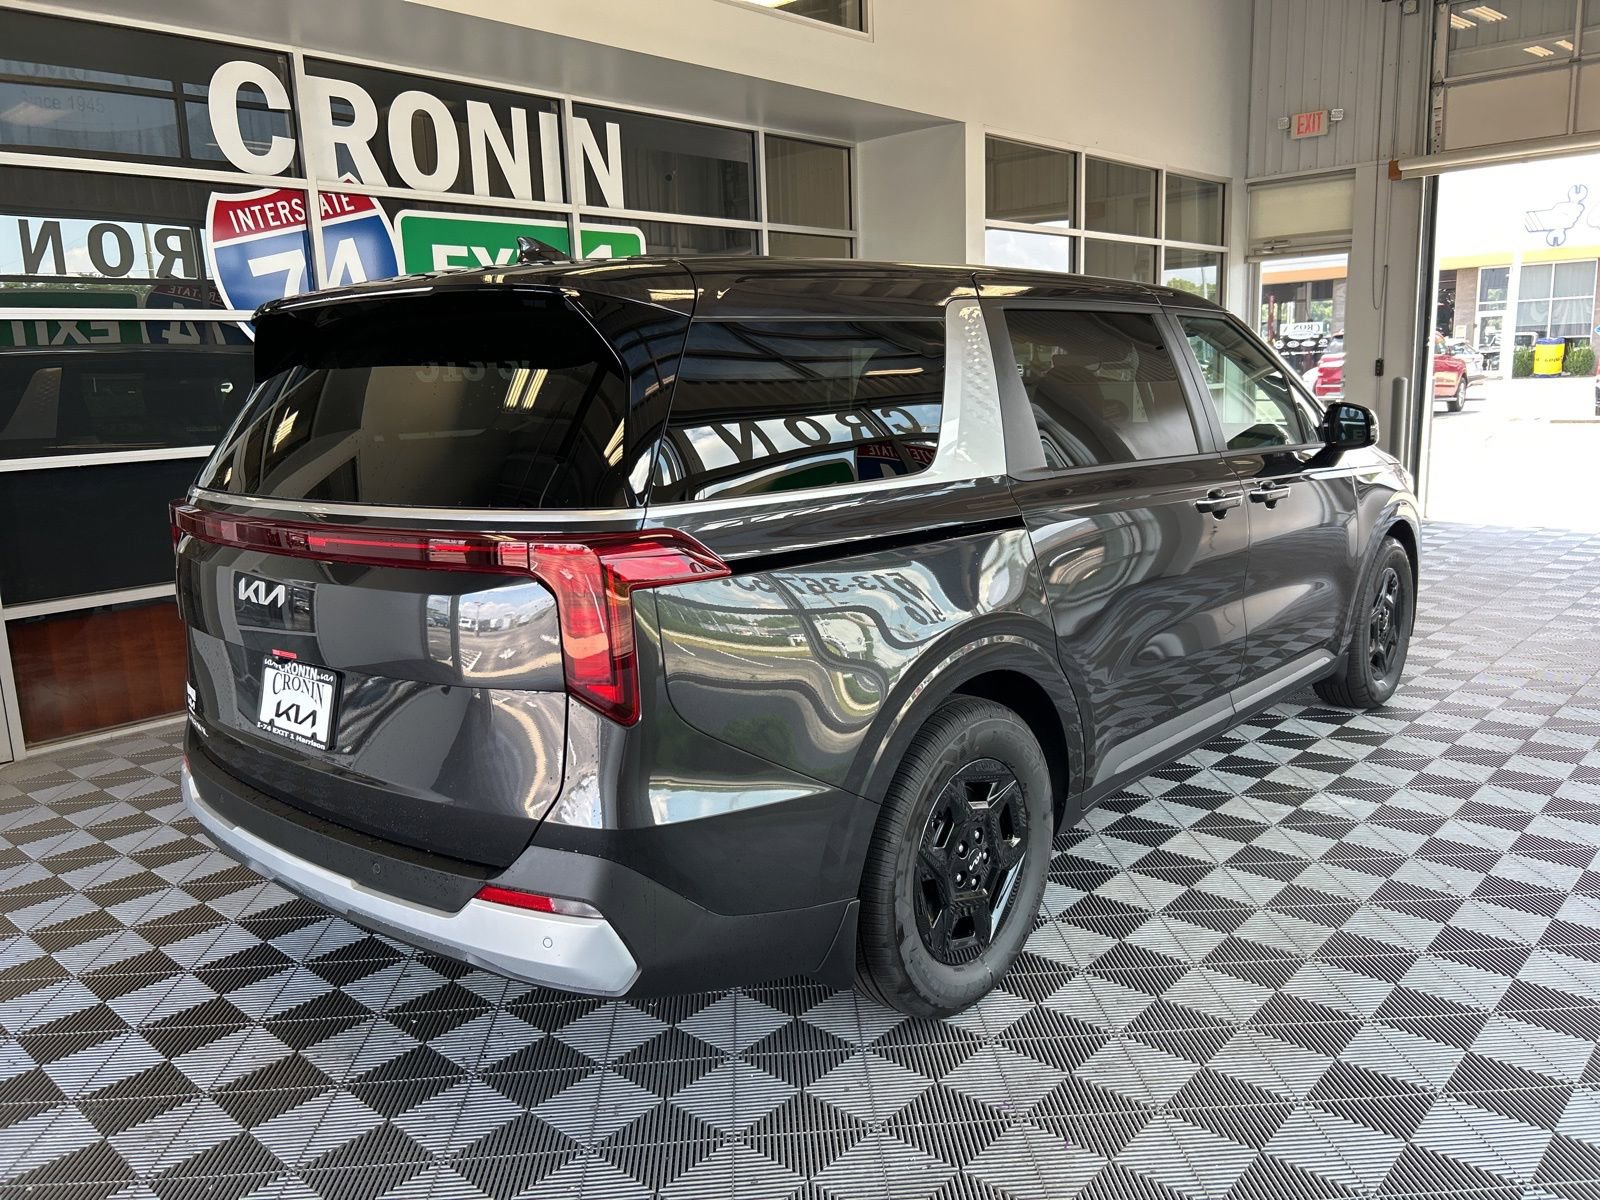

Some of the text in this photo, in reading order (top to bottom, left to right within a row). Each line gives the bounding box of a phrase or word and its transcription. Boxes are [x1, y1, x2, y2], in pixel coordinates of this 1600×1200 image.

[207, 60, 624, 208] CRONIN
[1296, 111, 1323, 136] EXIT
[229, 192, 356, 234] INTERSATE
[238, 577, 285, 608] KIA
[273, 672, 324, 709] CRONIN
[275, 700, 317, 729] KIA
[272, 727, 290, 738] EXIT
[295, 735, 326, 751] Harrison
